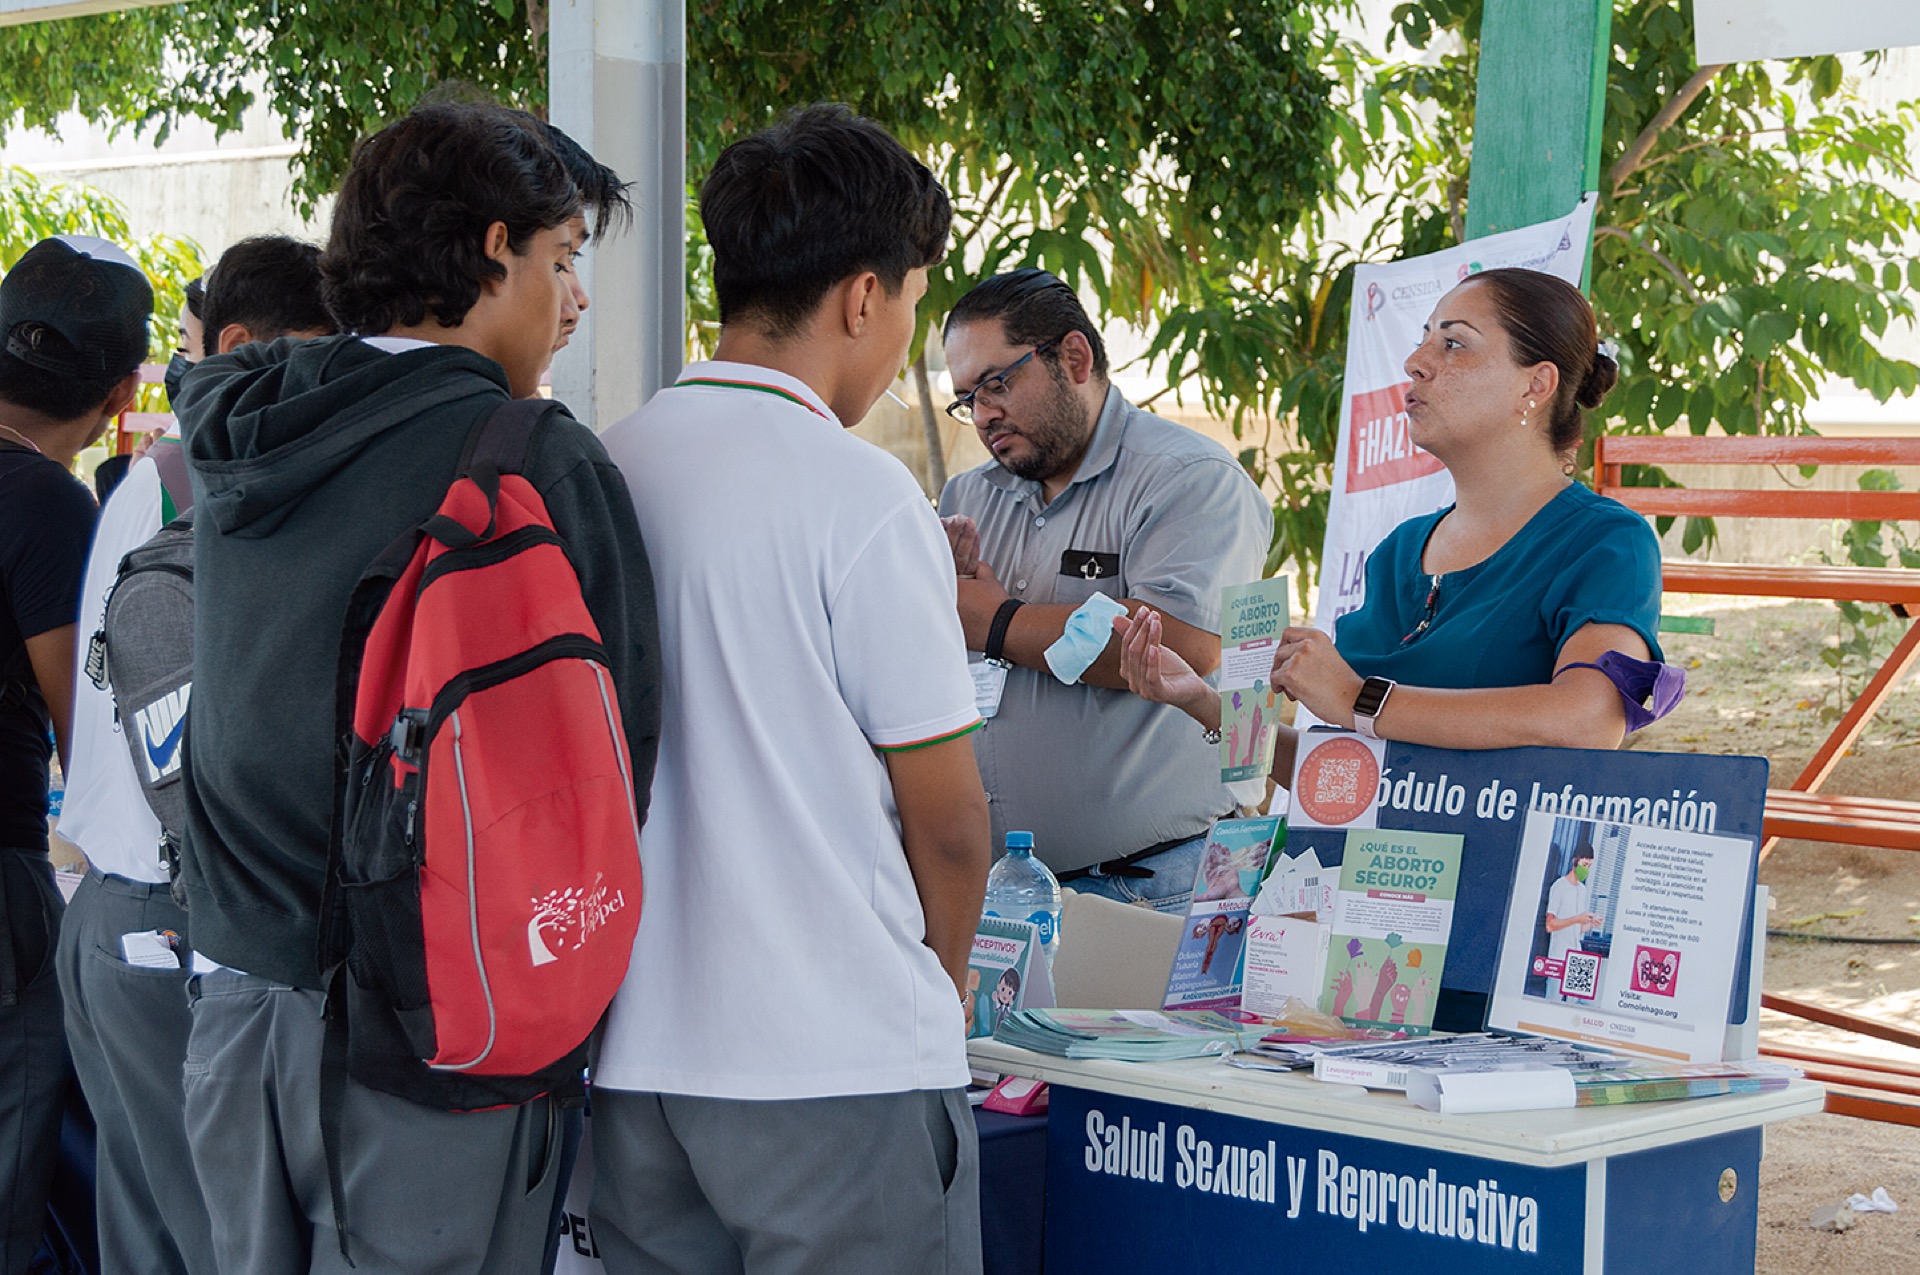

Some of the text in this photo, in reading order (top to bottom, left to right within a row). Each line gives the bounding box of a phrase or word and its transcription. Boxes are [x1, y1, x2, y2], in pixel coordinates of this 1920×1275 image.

[1392, 280, 1442, 300] CENSIDA
[1357, 411, 1425, 475] ¡HAZT
[1239, 602, 1280, 623] ABORTO
[1231, 619, 1277, 639] SEGURO?
[88, 638, 104, 680] NIKE
[135, 682, 192, 783] NIK
[1379, 768, 1717, 833] ódulo de Información
[1360, 842, 1418, 855] ¿QUÉ ES EL
[1369, 855, 1445, 874] ABORTO
[1355, 870, 1437, 890] SEGURO?
[972, 938, 1017, 953] NCEPTIVOS
[1617, 1000, 1678, 1019] Comolehago.org
[1085, 1109, 1539, 1254] Salud Sexual y Reproductiva
